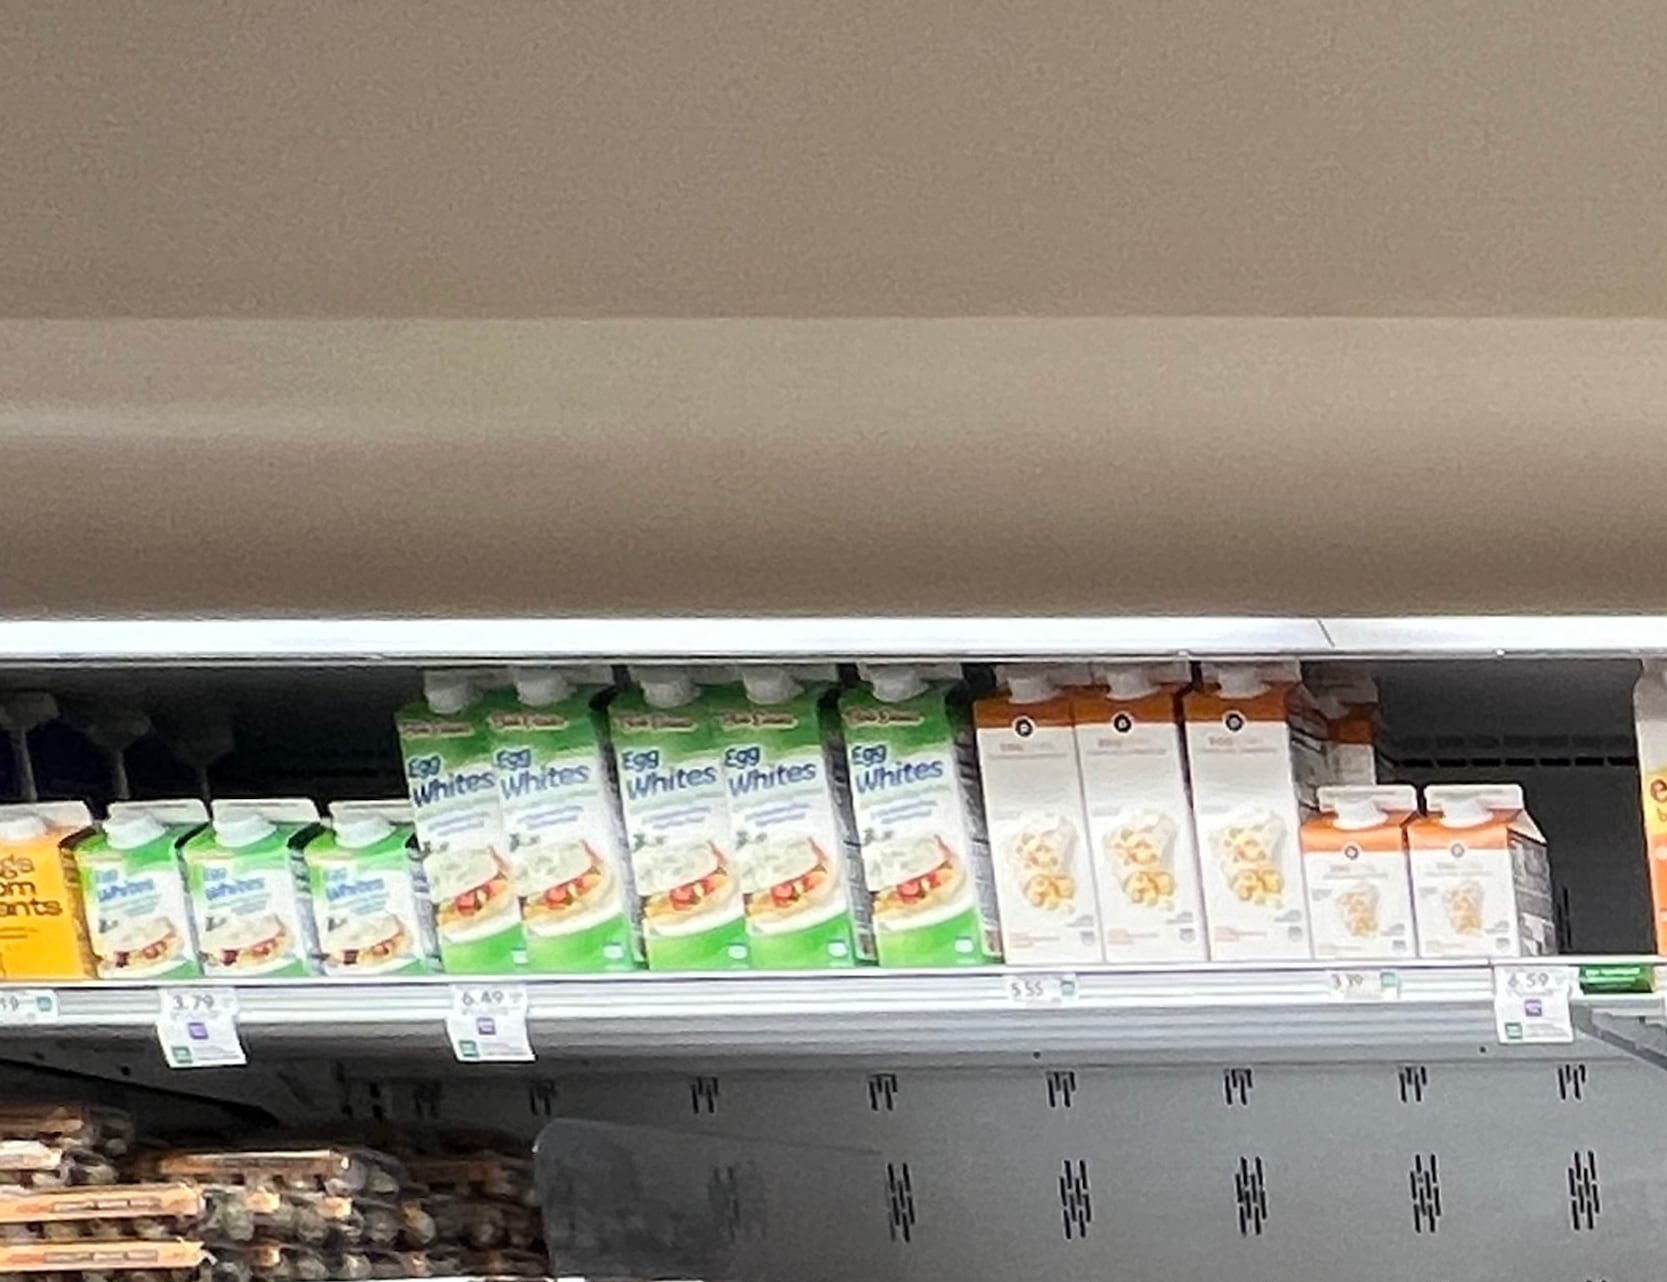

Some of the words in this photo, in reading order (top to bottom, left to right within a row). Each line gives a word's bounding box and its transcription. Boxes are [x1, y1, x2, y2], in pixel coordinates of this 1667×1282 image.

[408, 755, 441, 778] Egg
[497, 749, 531, 770] Egg
[623, 750, 659, 771] Egg
[724, 747, 761, 769] Egg
[852, 744, 887, 766] Egg
[500, 764, 590, 800] Whites
[627, 765, 717, 800] Whites
[728, 763, 816, 797] Whites
[856, 759, 943, 794] Whites
[413, 771, 495, 807] Whites
[0, 897, 63, 917] ants
